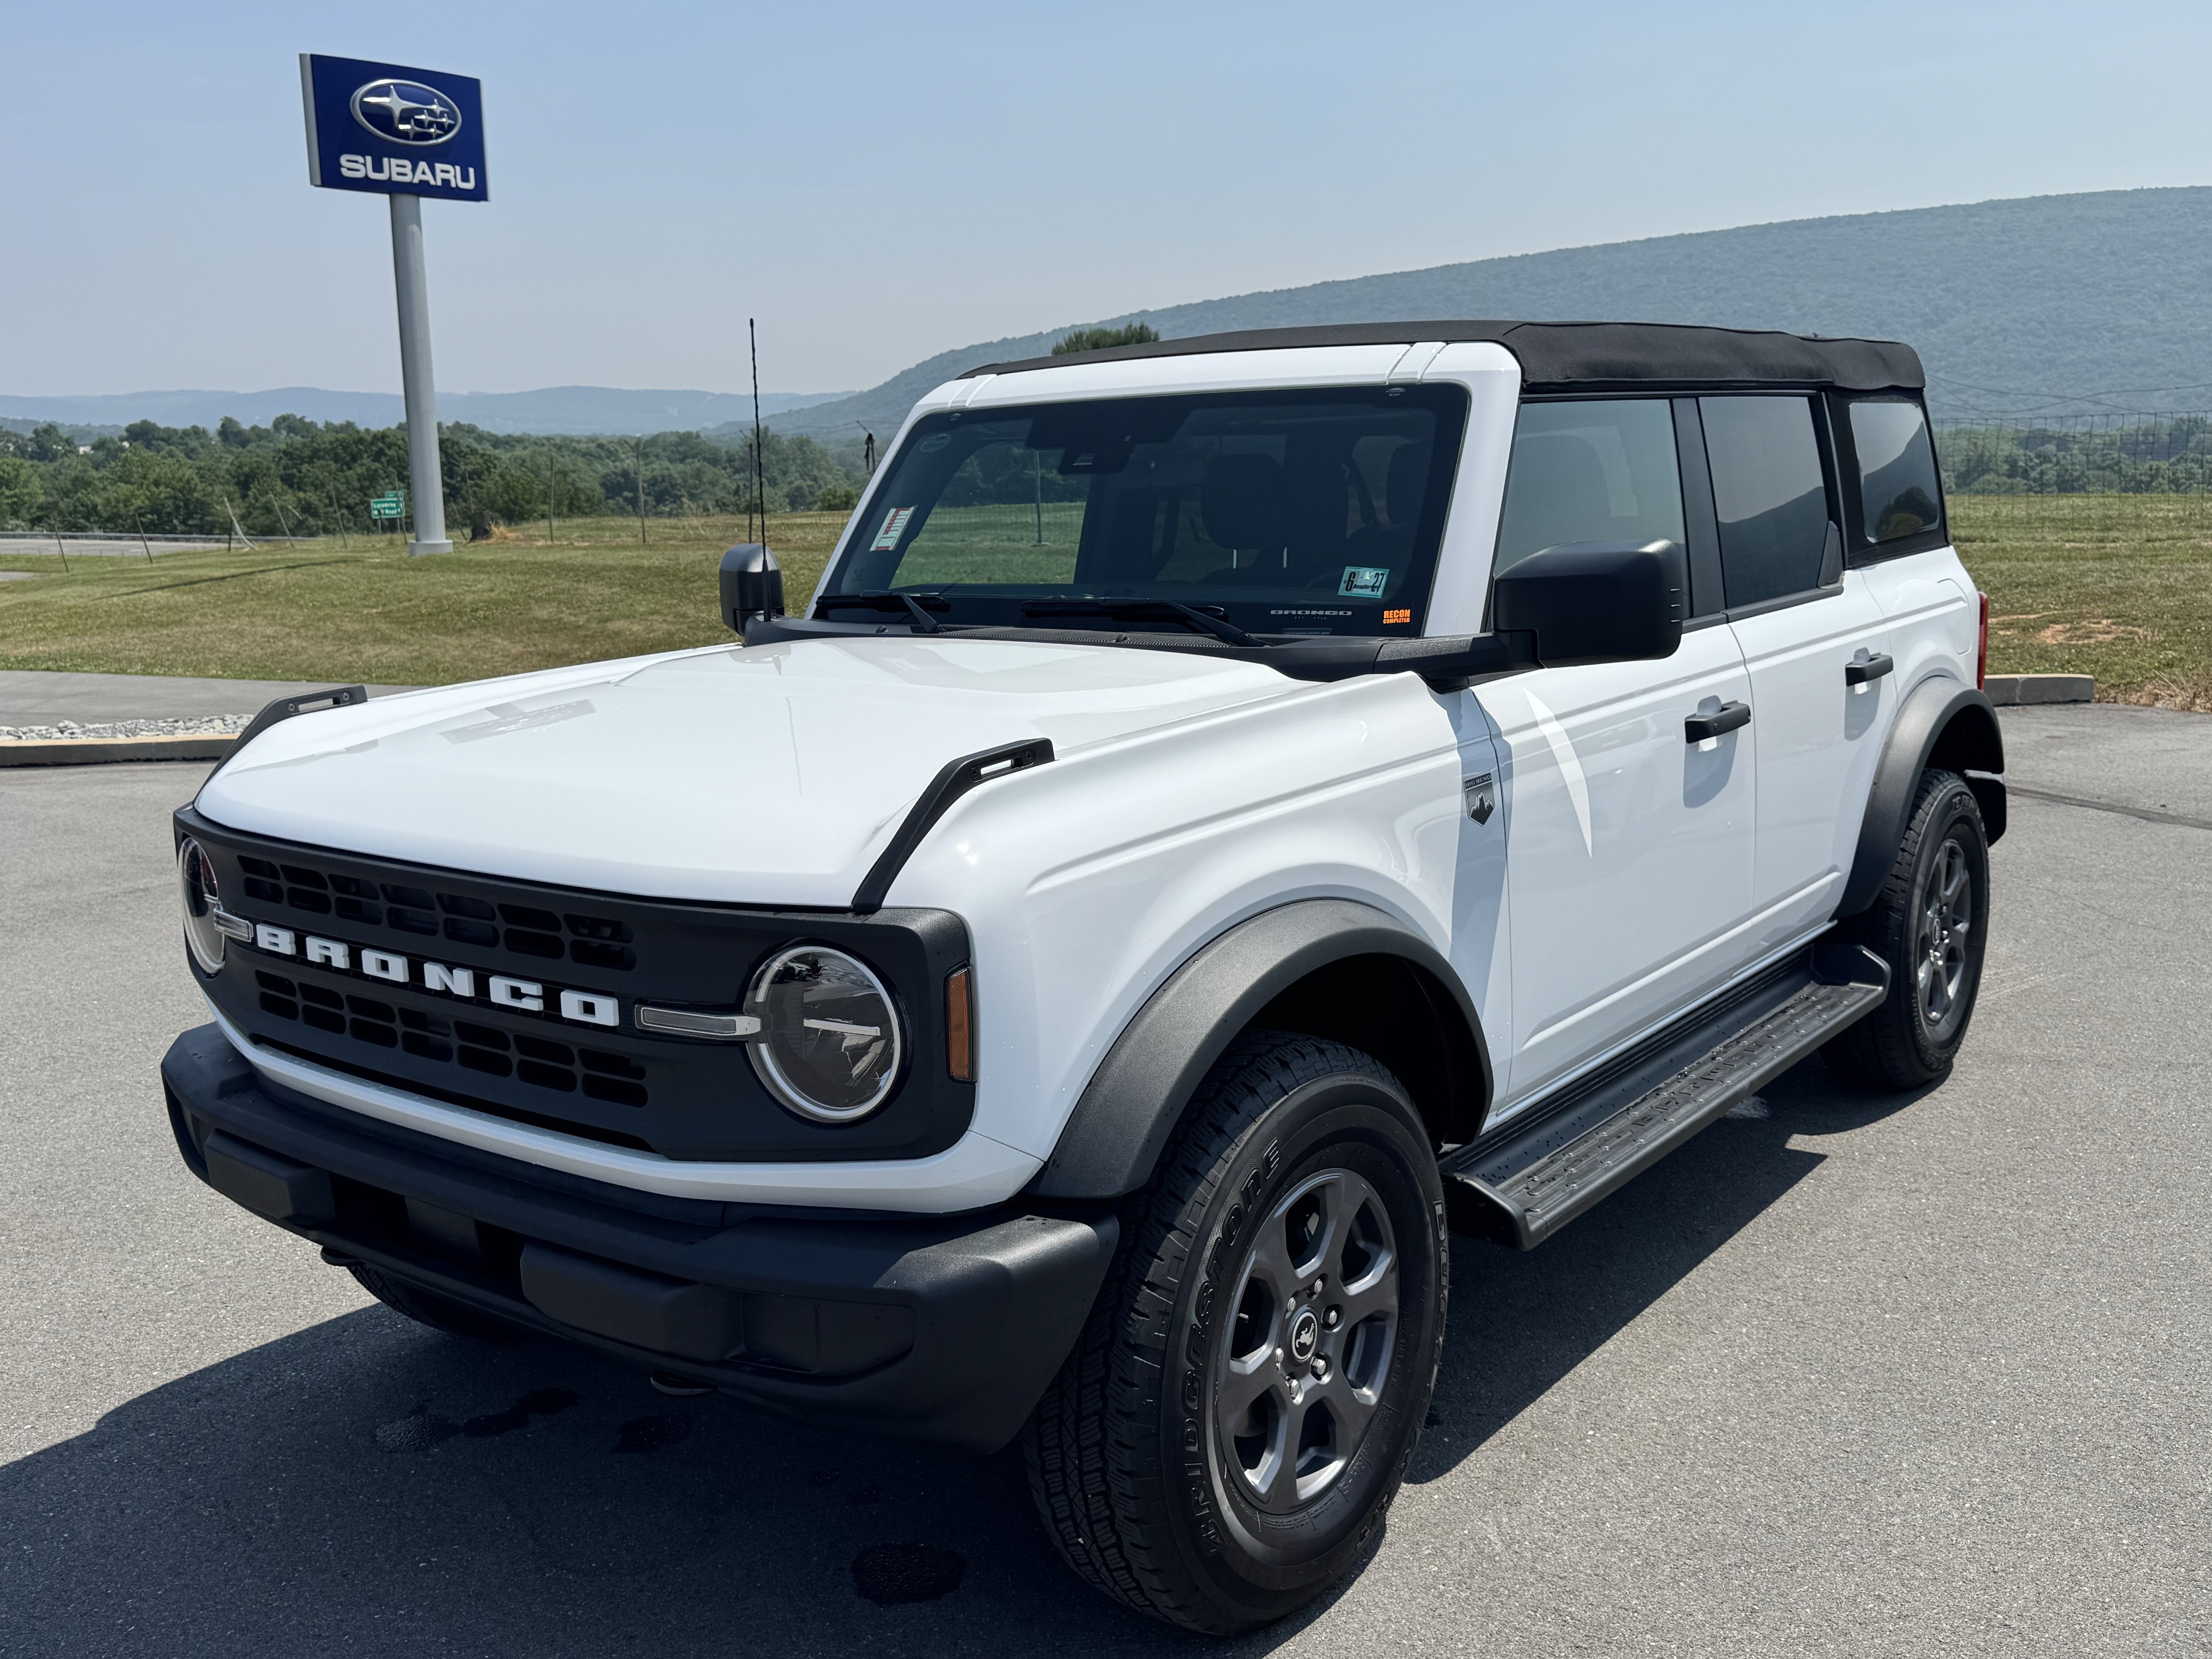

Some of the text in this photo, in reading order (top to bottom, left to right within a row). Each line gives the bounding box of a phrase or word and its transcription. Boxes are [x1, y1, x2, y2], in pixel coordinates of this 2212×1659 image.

[339, 154, 476, 190] SUBARU
[1345, 572, 1385, 593] 6 27
[1384, 609, 1410, 618] RECON
[256, 923, 620, 1027] BRONCO
[1182, 1138, 1279, 1551] BRIDGESTONE
